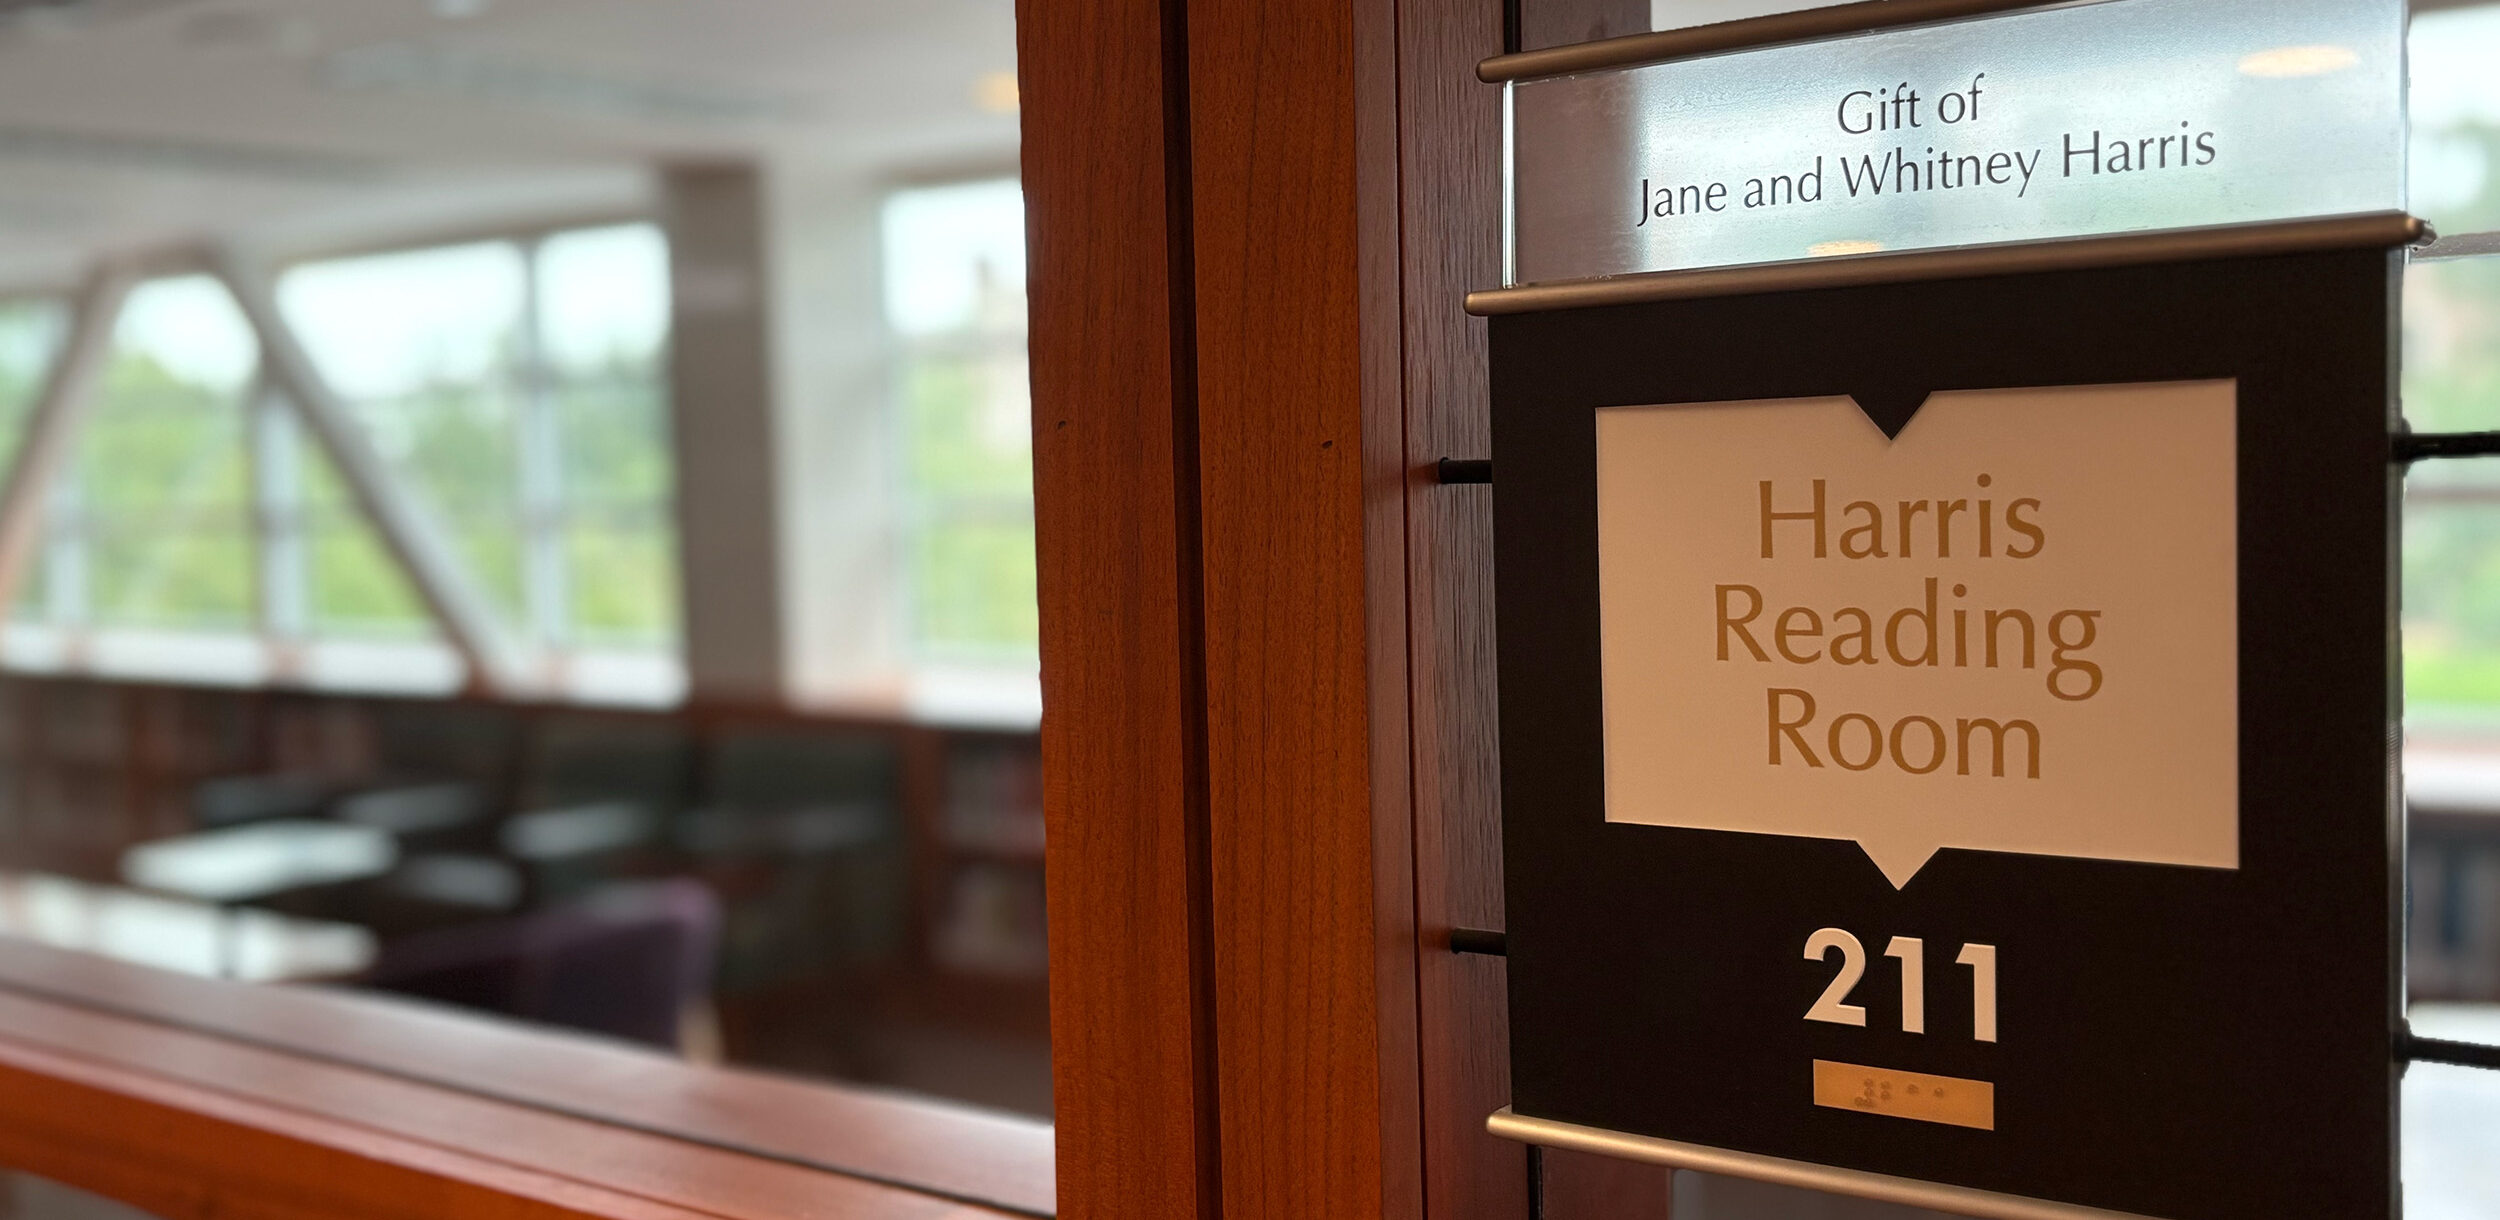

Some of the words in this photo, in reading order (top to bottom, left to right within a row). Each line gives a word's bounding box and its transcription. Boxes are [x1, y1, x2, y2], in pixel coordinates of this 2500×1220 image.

[1836, 82, 1922, 136] Gift
[1936, 72, 1986, 125] of
[1637, 174, 1728, 228] Jane
[1743, 156, 1824, 208] and
[1840, 146, 2041, 199] Whitney
[2061, 121, 2217, 178] Harris
[1758, 473, 2046, 560] Harris
[1714, 577, 2103, 701] Reading
[1766, 687, 2041, 779] Room
[1803, 927, 1997, 1043] 211
